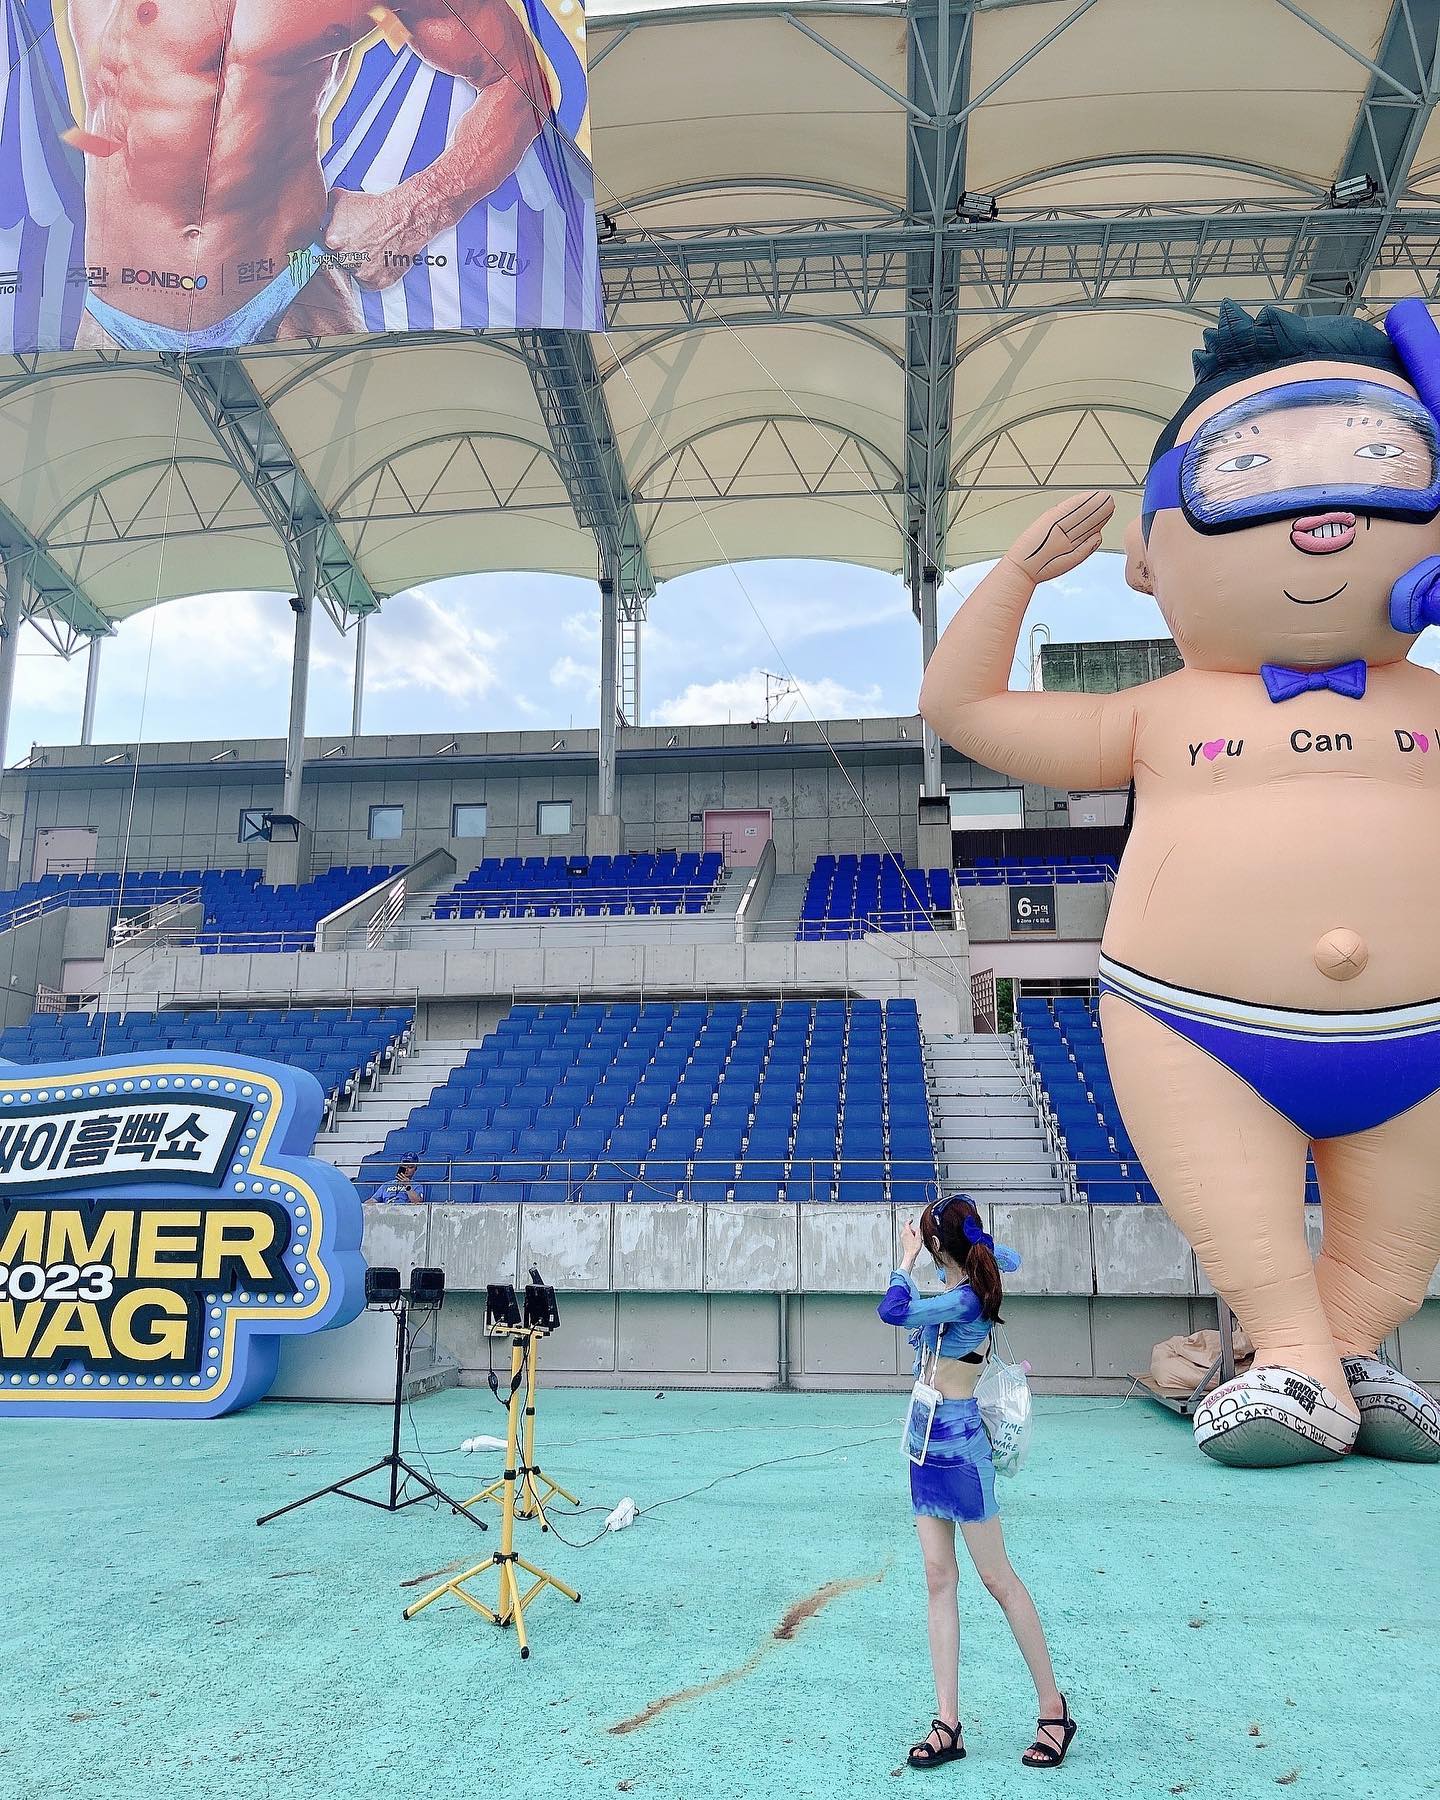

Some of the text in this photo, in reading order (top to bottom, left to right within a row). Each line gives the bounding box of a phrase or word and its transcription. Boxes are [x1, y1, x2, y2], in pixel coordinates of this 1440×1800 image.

[312, 251, 371, 265] MONSTER
[464, 247, 530, 276] Kelly
[66, 266, 109, 288] 주관
[236, 258, 275, 284] 협찬
[1290, 729, 1353, 753] Can
[0, 1264, 114, 1301] 023
[1000, 1420, 1023, 1434] TIME
[1412, 1411, 1440, 1441] HOM
[993, 1439, 1018, 1452] WAKE
